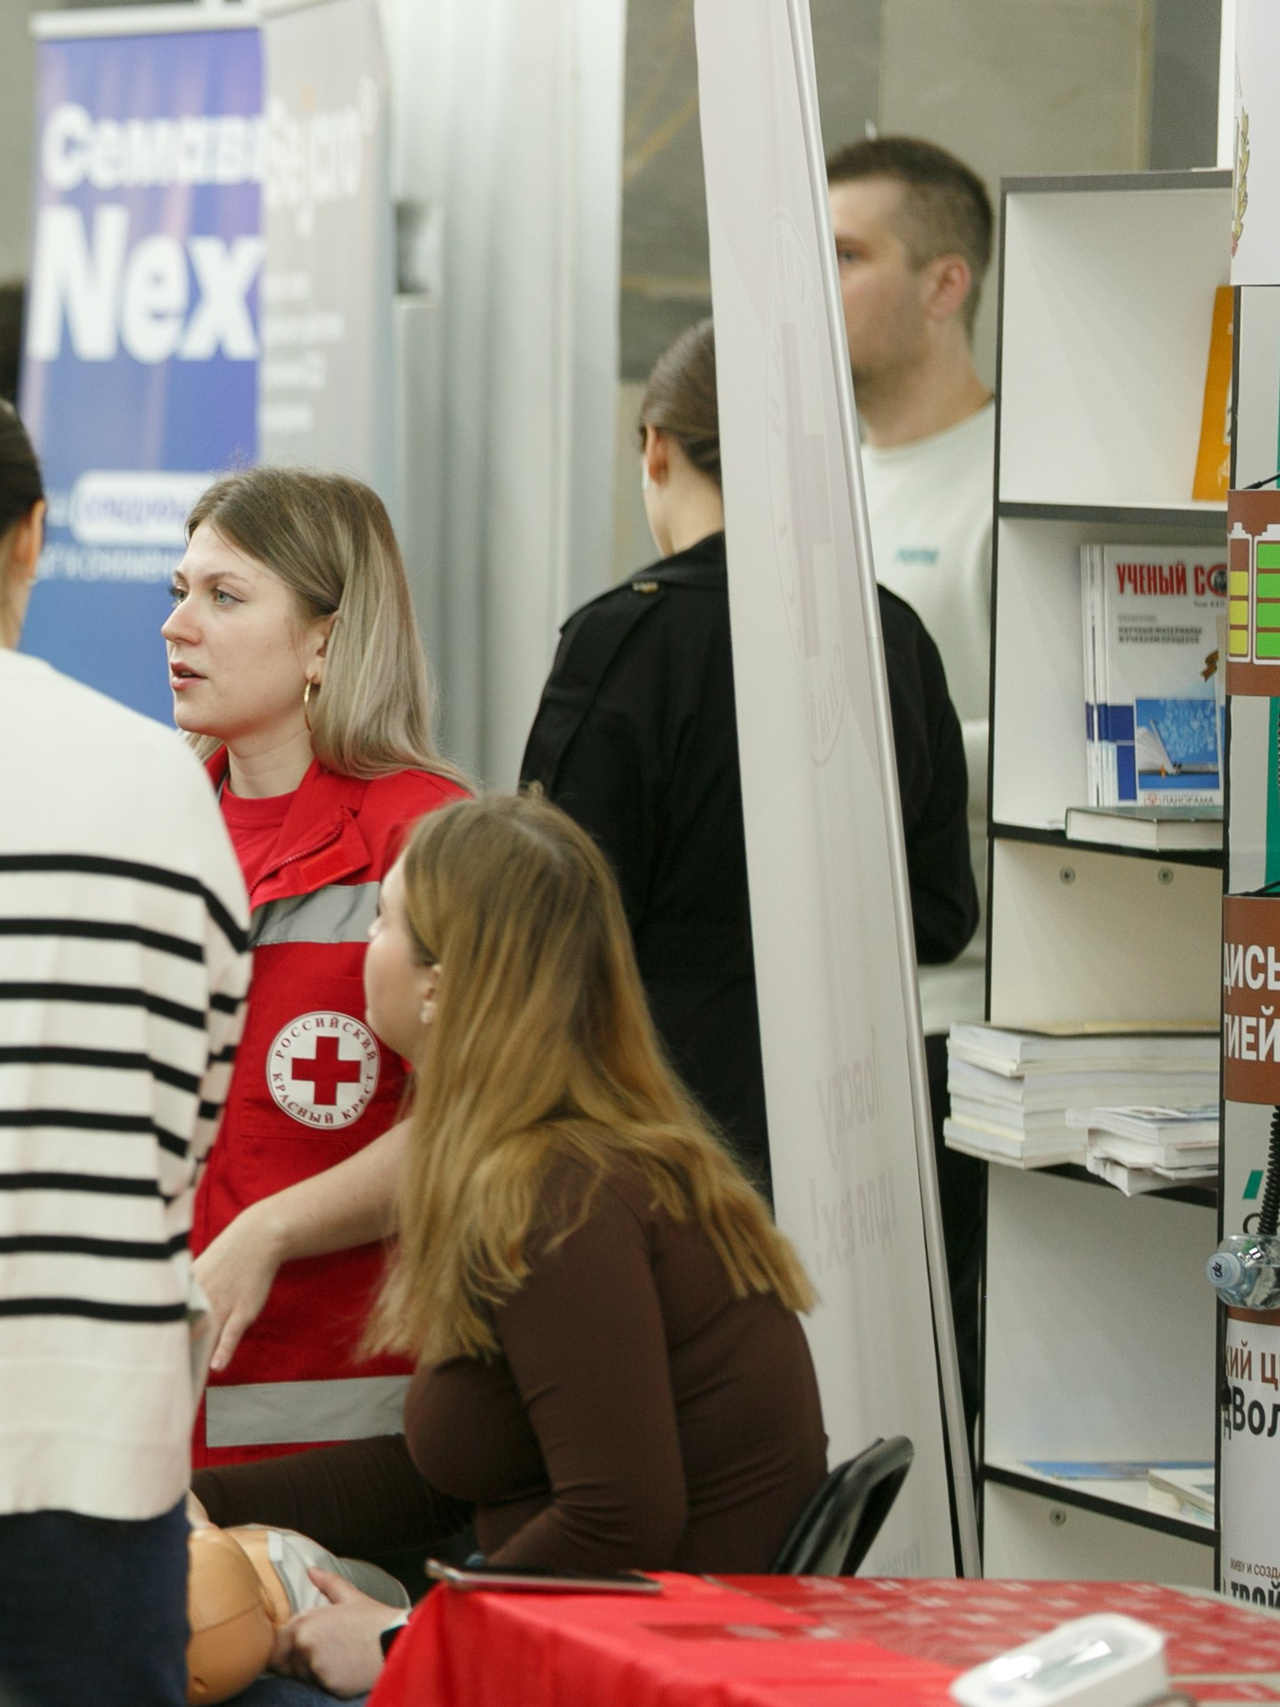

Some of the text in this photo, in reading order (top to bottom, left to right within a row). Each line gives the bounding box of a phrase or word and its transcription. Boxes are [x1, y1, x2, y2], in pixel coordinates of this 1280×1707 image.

[1116, 561, 1187, 595] УЧЕНЫЙ
[275, 1015, 378, 1060] РОССИЙСКИЙ
[272, 1071, 375, 1124] КРАСНЫЙ КРЕСТ
[1261, 1352, 1280, 1391] Ц
[1246, 1562, 1253, 1574] И
[1254, 1563, 1280, 1580] СОЗД
